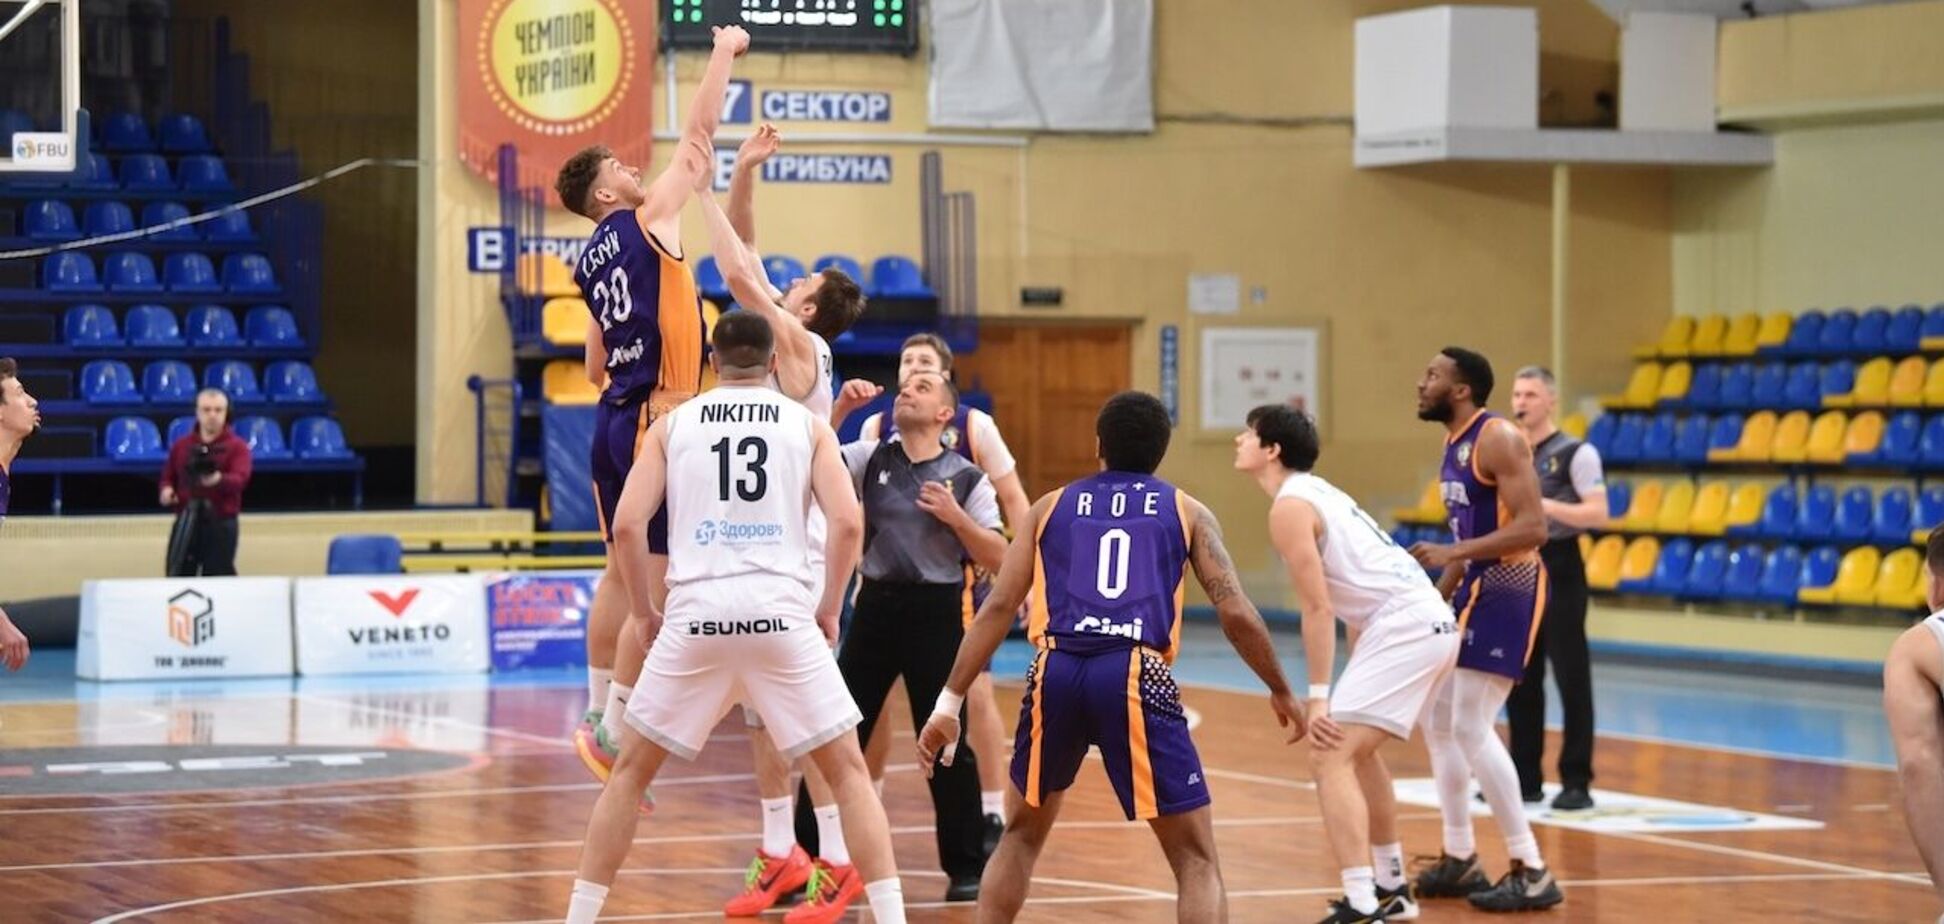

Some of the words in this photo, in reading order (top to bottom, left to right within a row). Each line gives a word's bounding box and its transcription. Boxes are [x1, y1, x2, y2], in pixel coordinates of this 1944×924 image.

[515, 10, 595, 56] ЧЕМПІОН
[515, 52, 595, 97] УКРАЇНИ
[763, 92, 888, 120] СЕКТОР
[37, 143, 68, 157] FBU
[765, 155, 890, 181] ТРИБУНА
[593, 266, 632, 331] 20
[700, 403, 779, 424] NIKITIN
[711, 435, 769, 502] 13
[1076, 491, 1161, 517] ROE
[1097, 528, 1131, 599] 0
[347, 623, 451, 645] VENETO
[702, 618, 790, 636] SUNOIL
